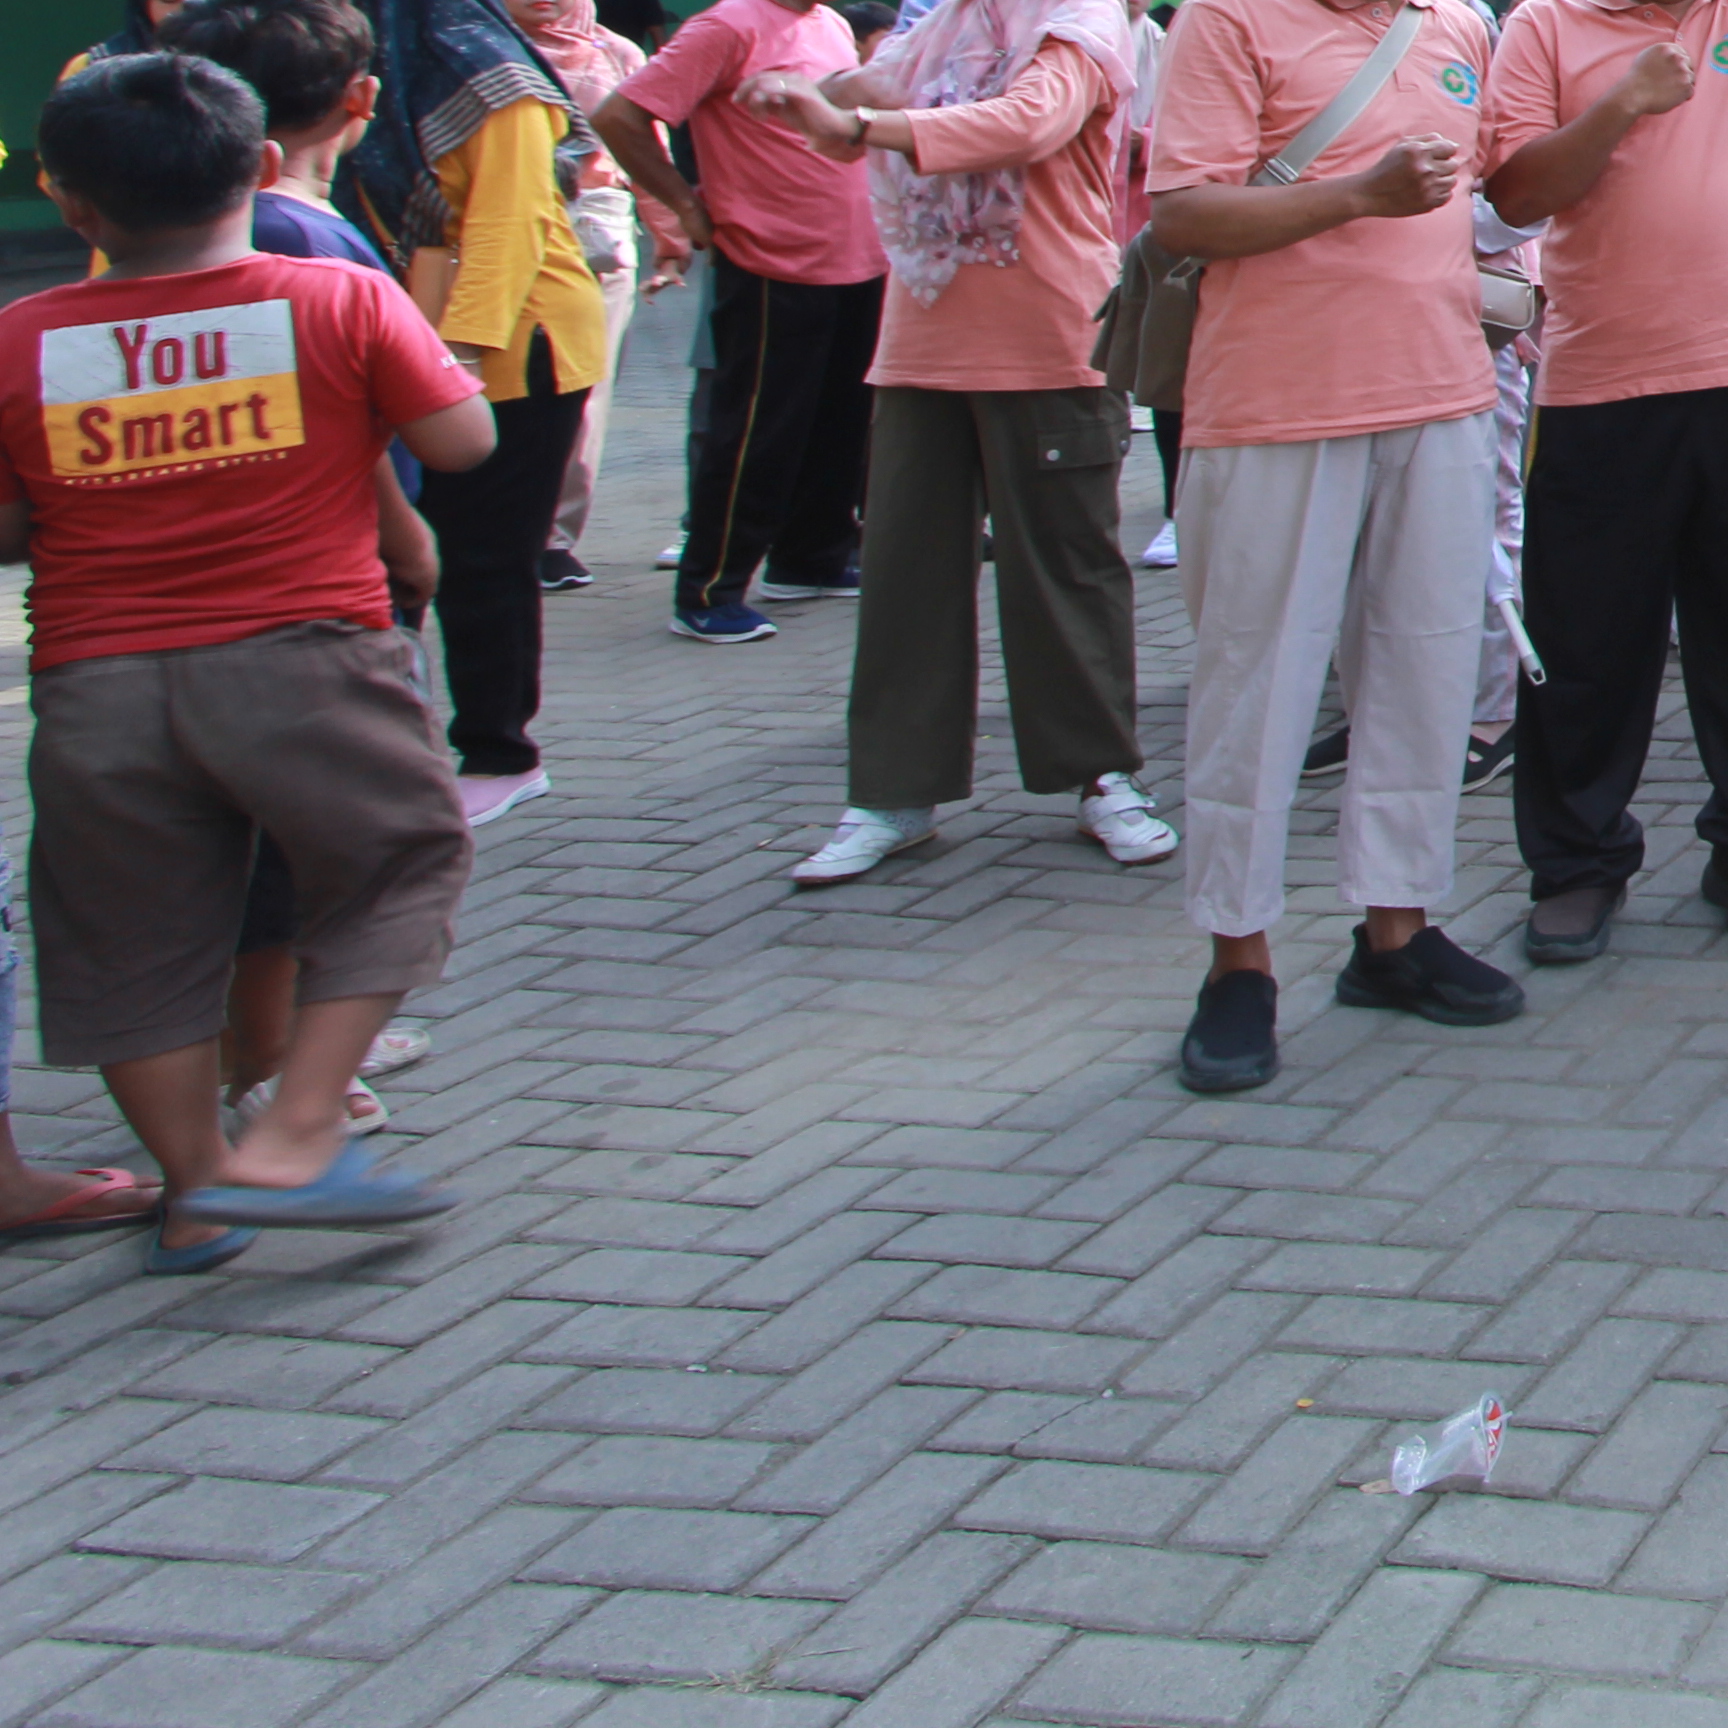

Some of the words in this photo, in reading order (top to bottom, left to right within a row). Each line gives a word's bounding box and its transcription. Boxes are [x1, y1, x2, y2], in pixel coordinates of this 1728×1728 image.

[113, 324, 228, 391] You
[77, 391, 273, 467] Smart
[214, 452, 291, 471] STYLE
